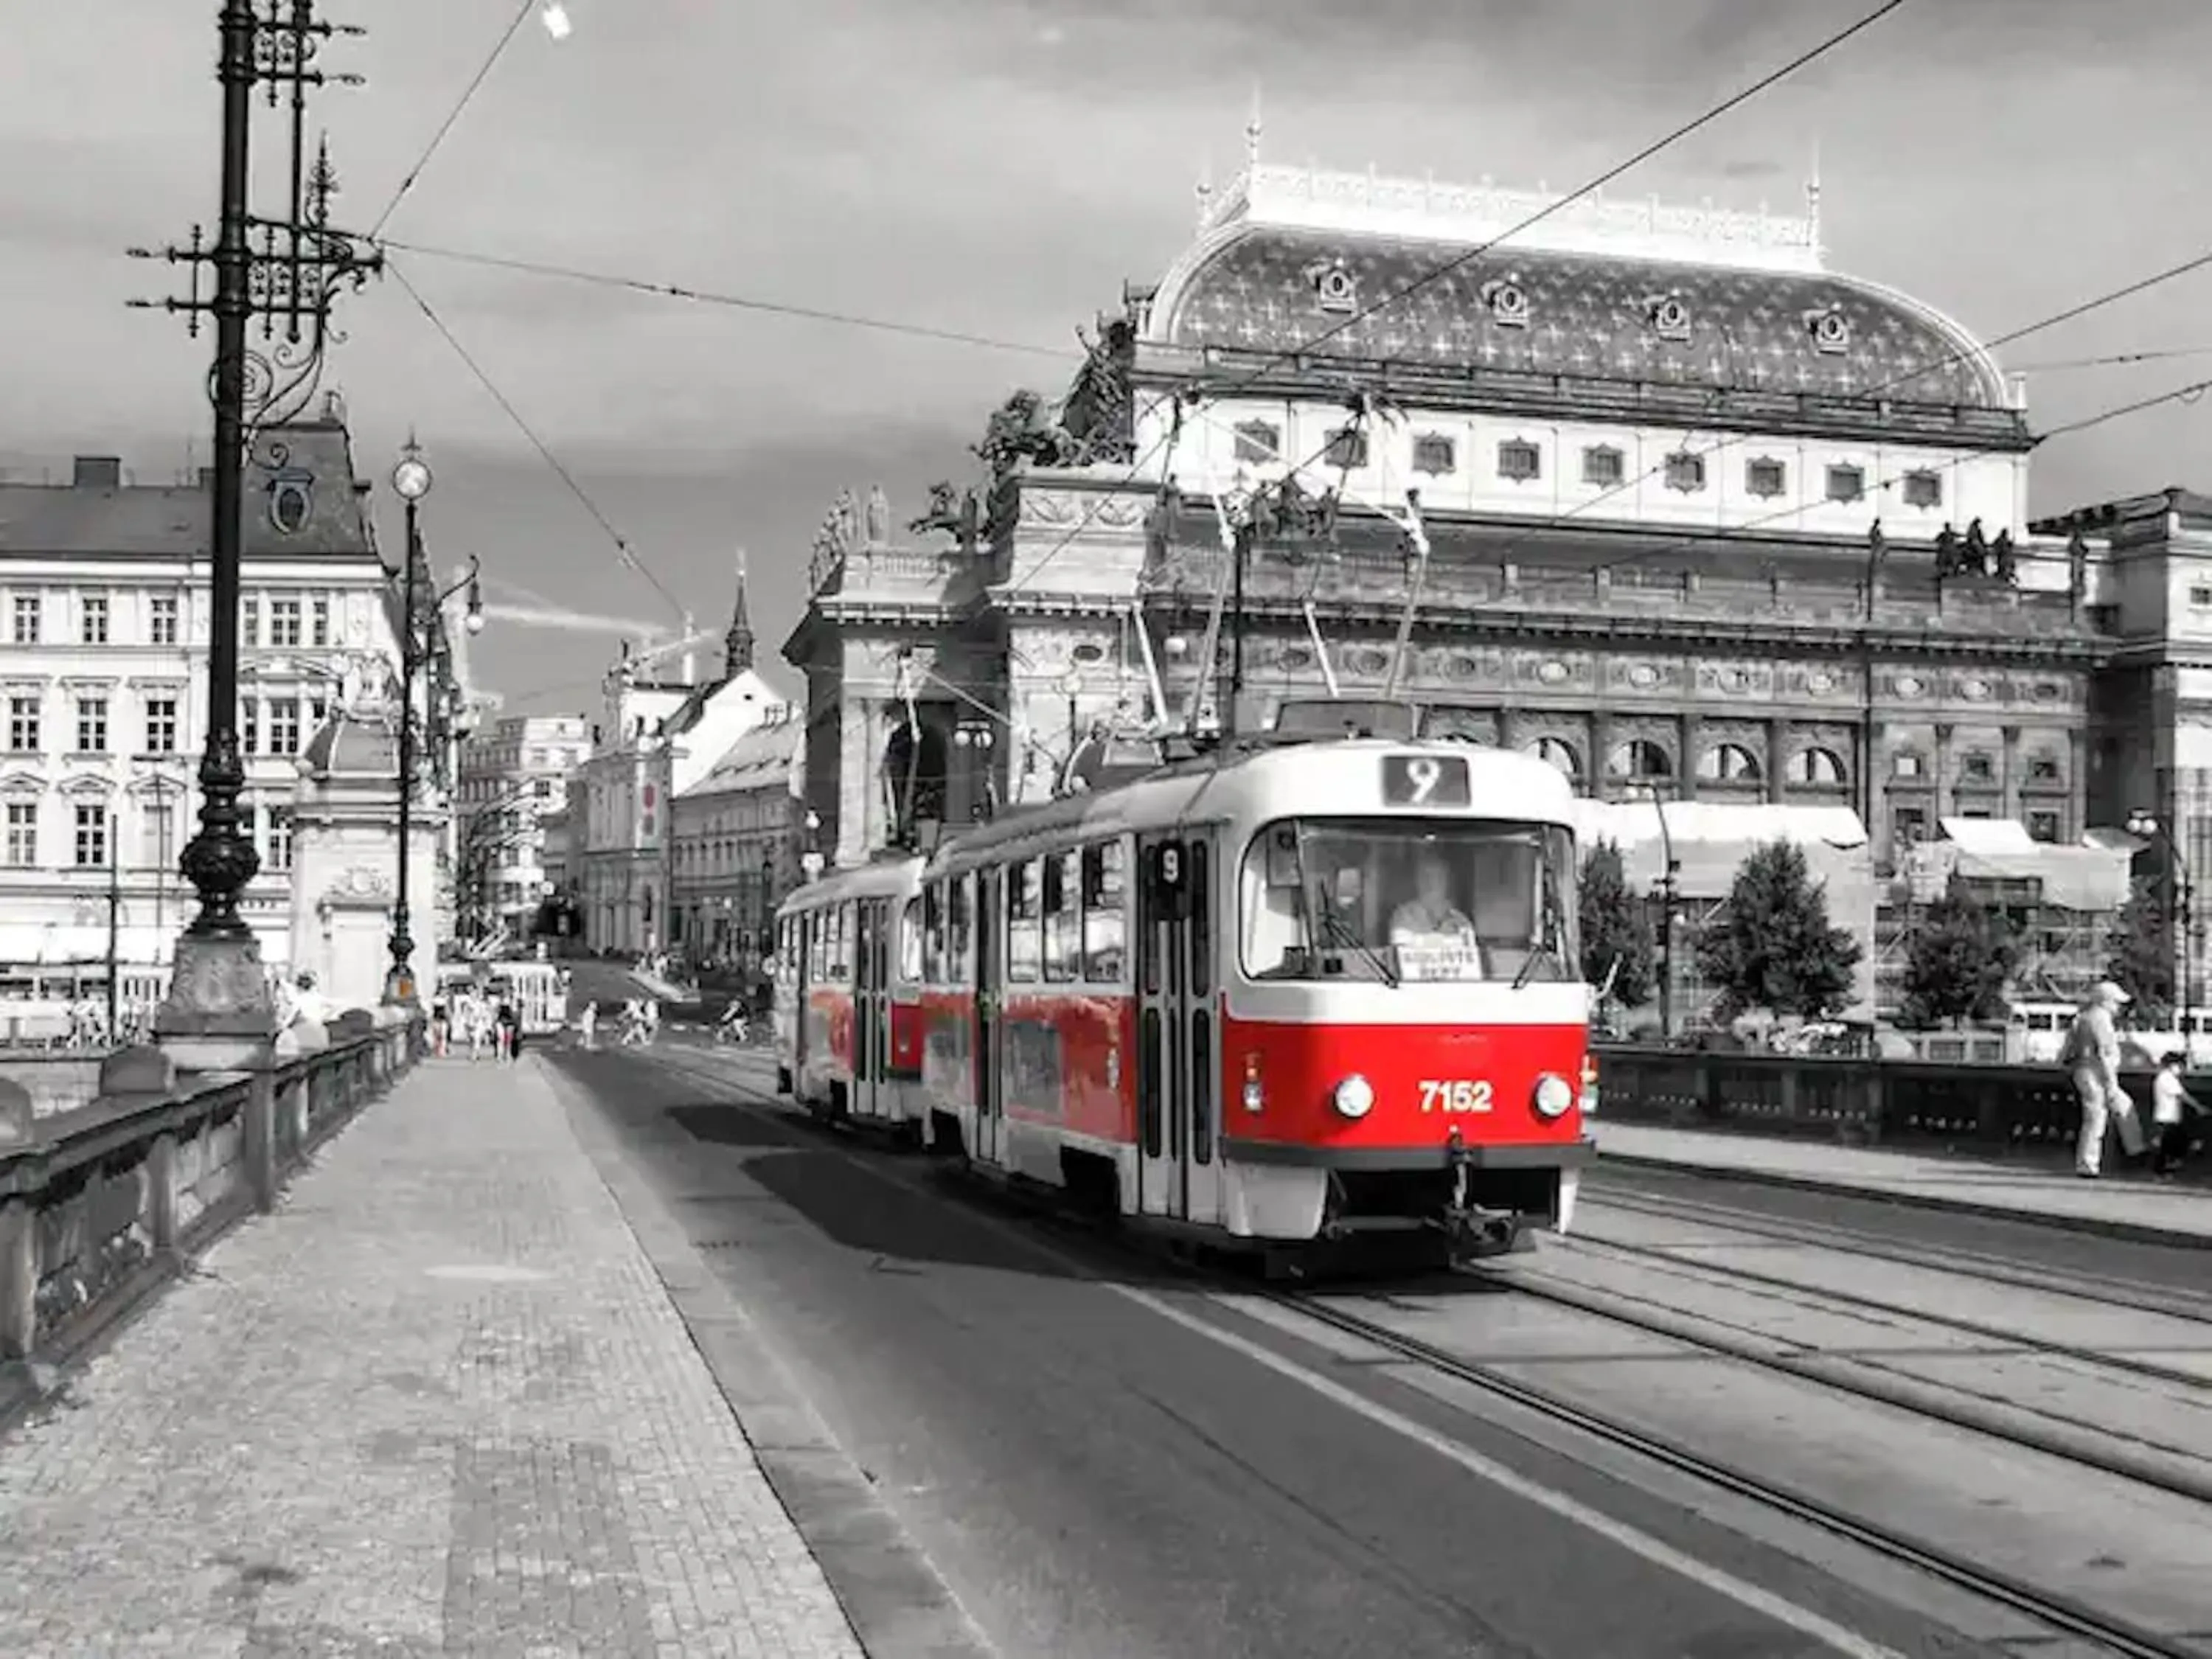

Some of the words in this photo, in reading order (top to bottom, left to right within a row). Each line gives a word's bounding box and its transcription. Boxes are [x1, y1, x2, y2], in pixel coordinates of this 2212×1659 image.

[1406, 759, 1440, 803] 9
[1164, 849, 1178, 883] 9
[1418, 1079, 1492, 1112] 7152
